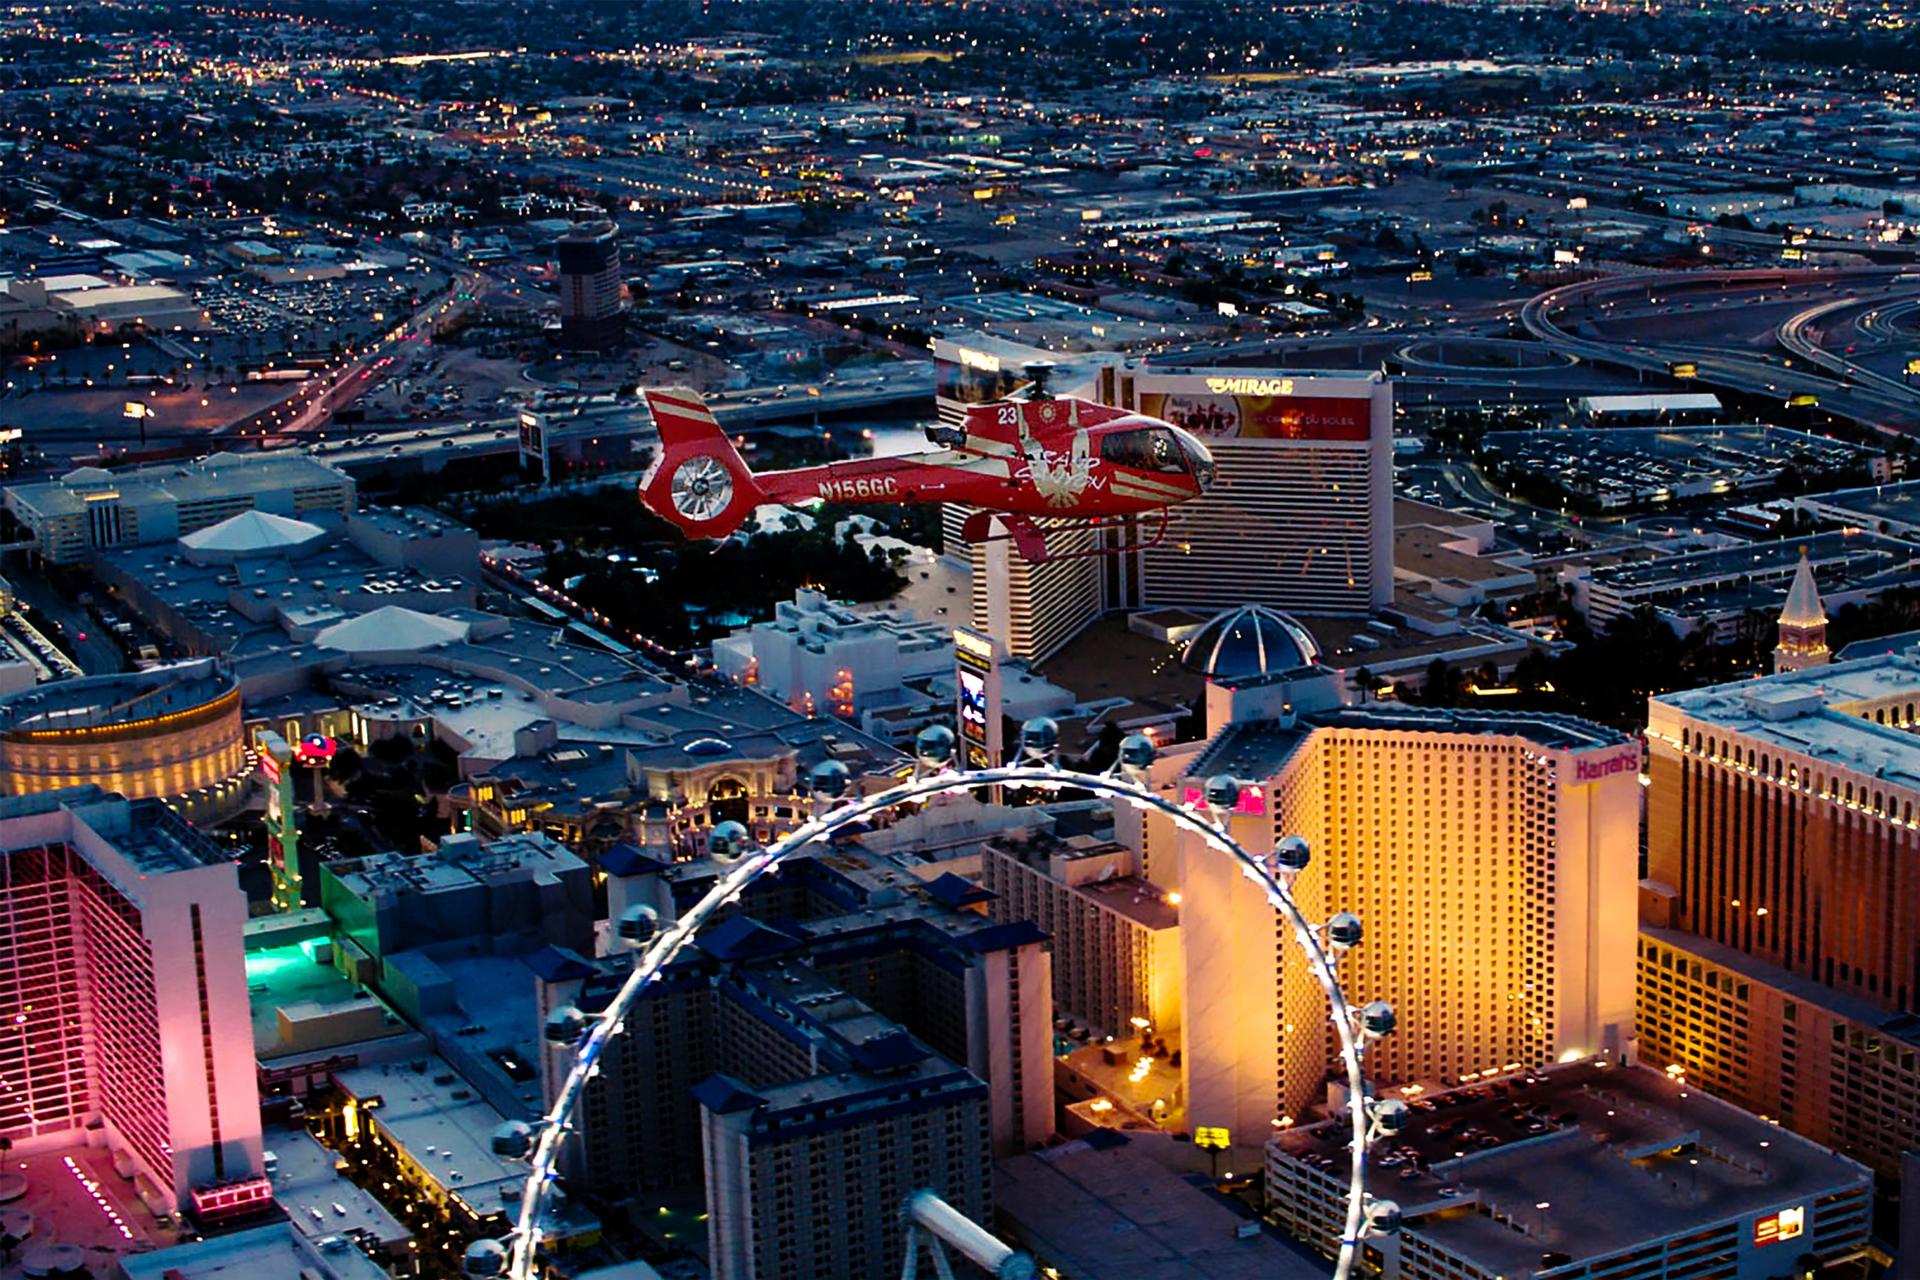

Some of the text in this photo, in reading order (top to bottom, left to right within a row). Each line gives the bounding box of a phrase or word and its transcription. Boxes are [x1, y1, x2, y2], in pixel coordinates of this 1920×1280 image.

[1226, 378, 1294, 396] MIRAGE
[998, 406, 1017, 425] 23
[817, 476, 898, 499] N156GC
